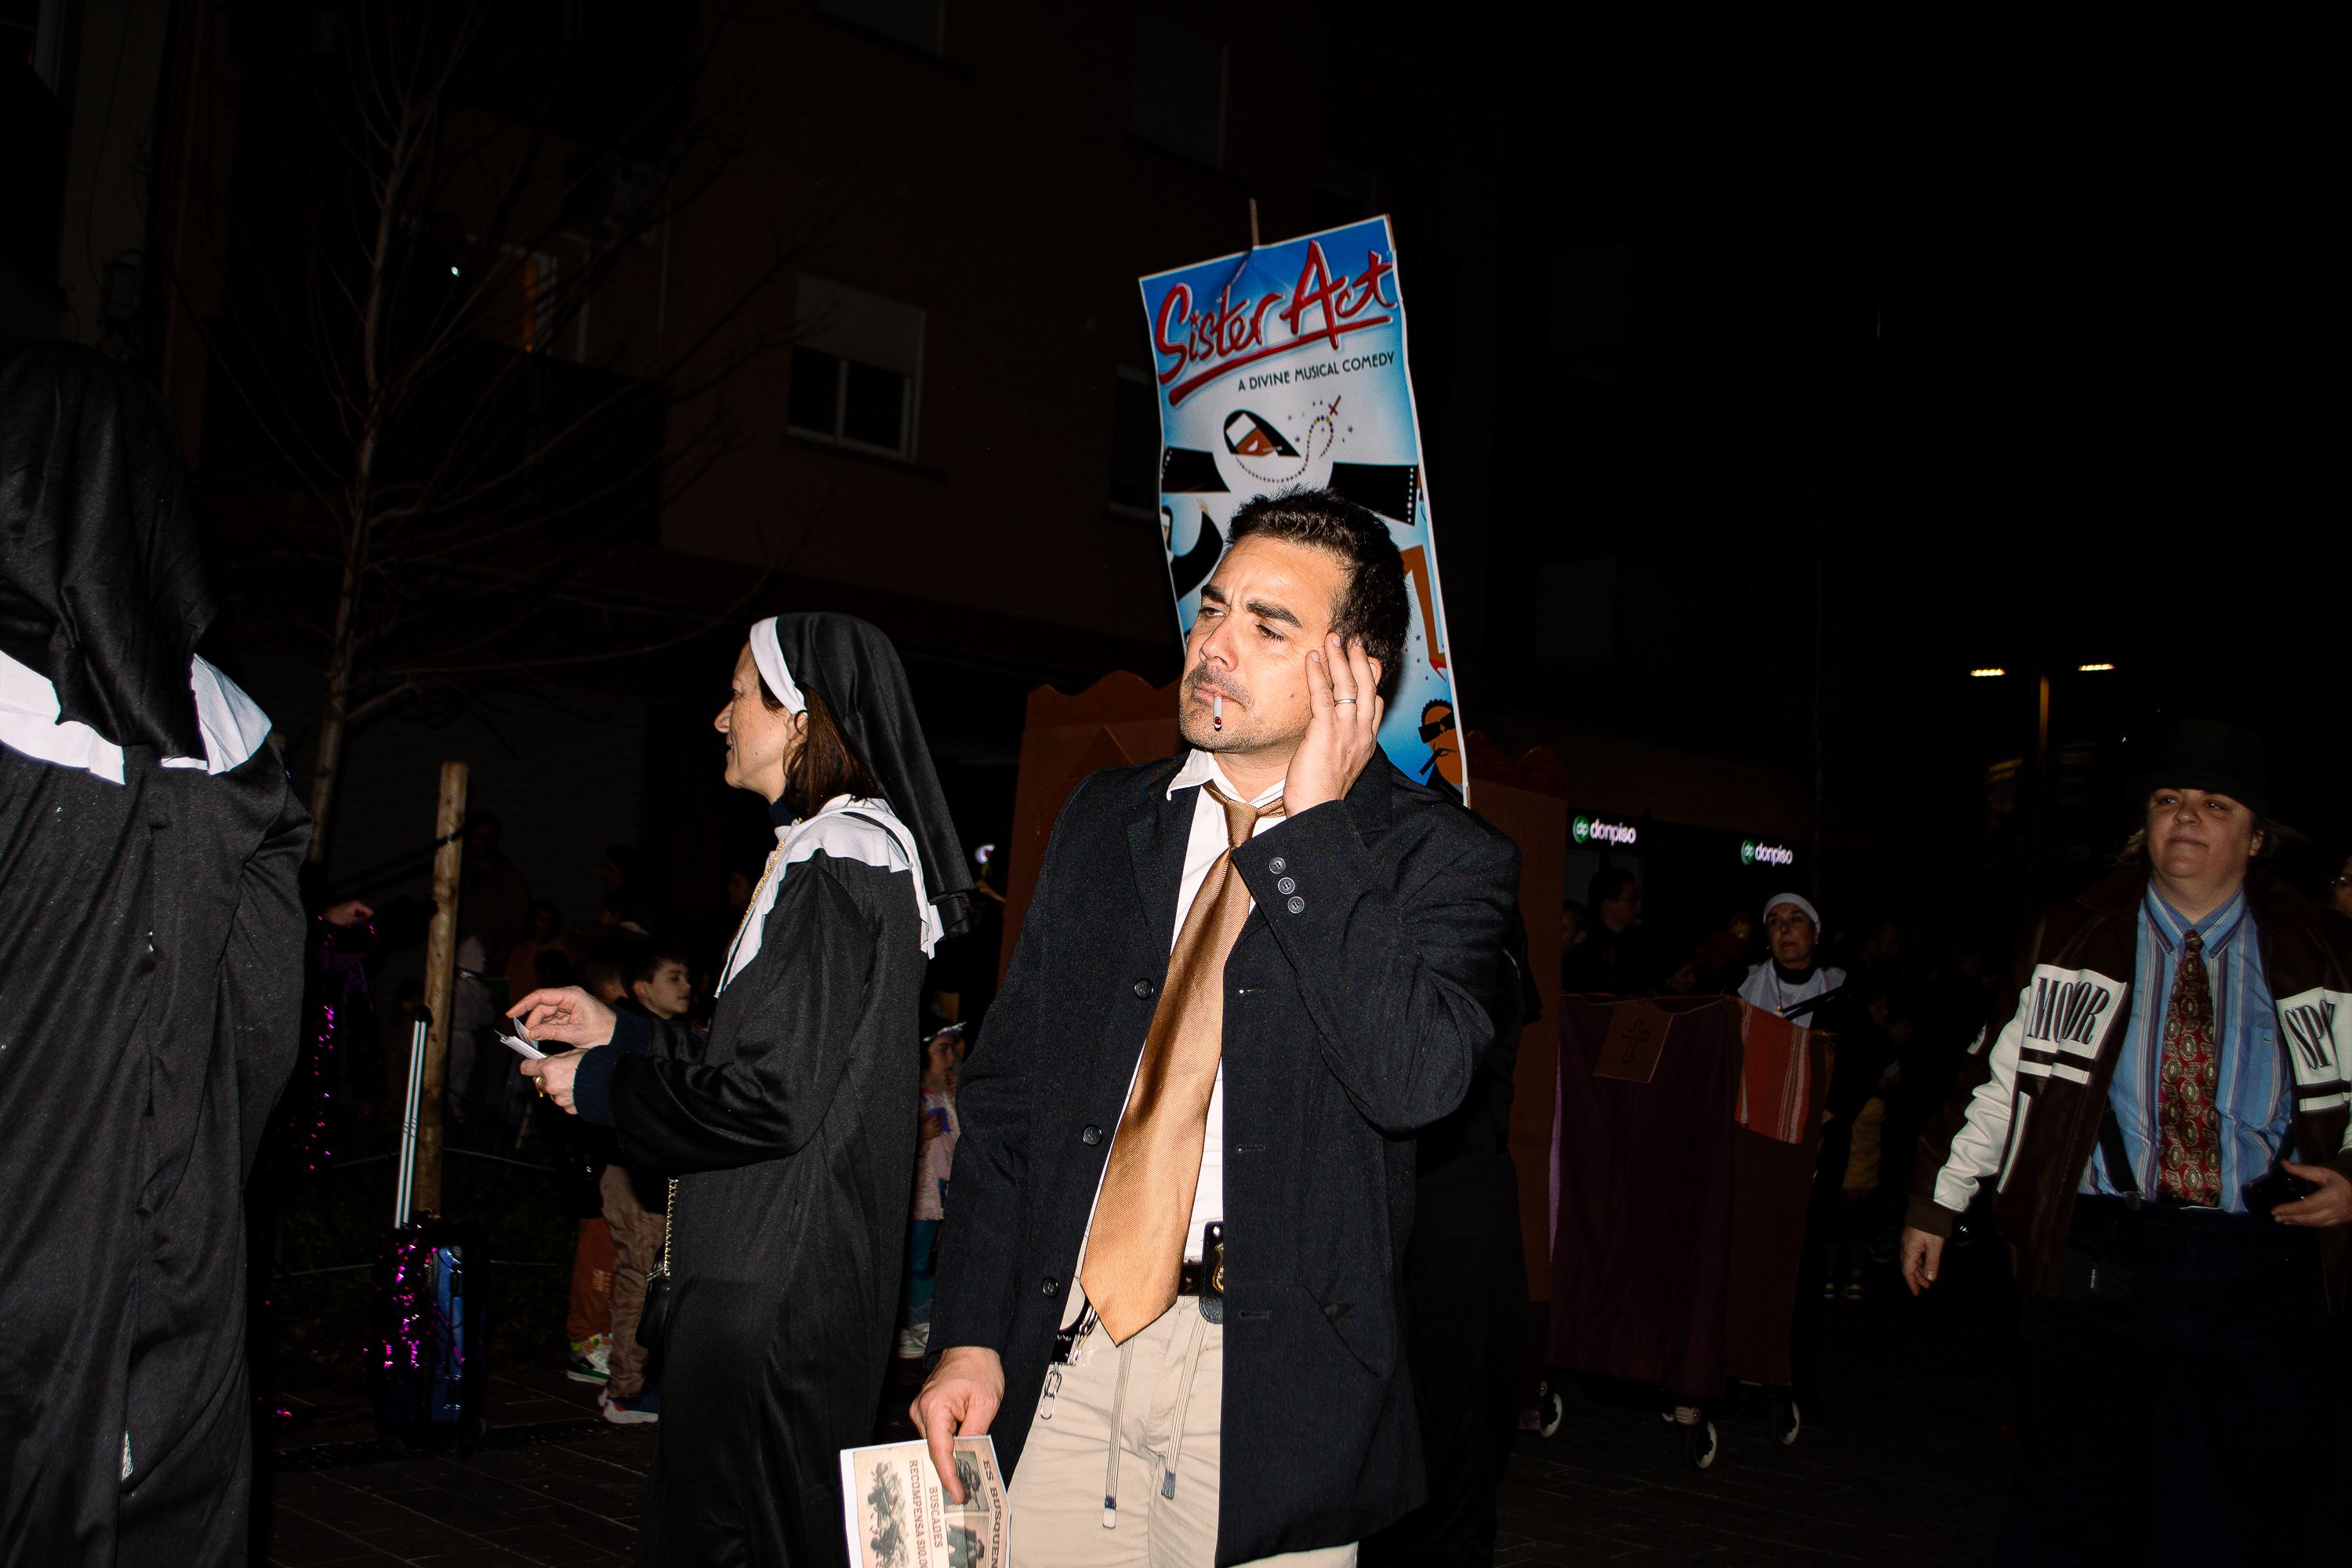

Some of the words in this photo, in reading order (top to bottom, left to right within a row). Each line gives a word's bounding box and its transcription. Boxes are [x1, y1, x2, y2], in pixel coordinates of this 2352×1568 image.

[1155, 281, 1283, 385] Sister
[1279, 240, 1398, 350] Act
[1238, 379, 1246, 392] A
[1249, 370, 1290, 390] DIVINE
[1294, 361, 1339, 382] MUSICAL
[1342, 350, 1395, 373] COMEDY
[1590, 818, 1637, 847] donpiso
[1755, 841, 1793, 867] donpiso
[983, 1459, 994, 1481] ES
[909, 1459, 925, 1537] RECOMPENSA
[929, 1486, 943, 1548] BUSCADES
